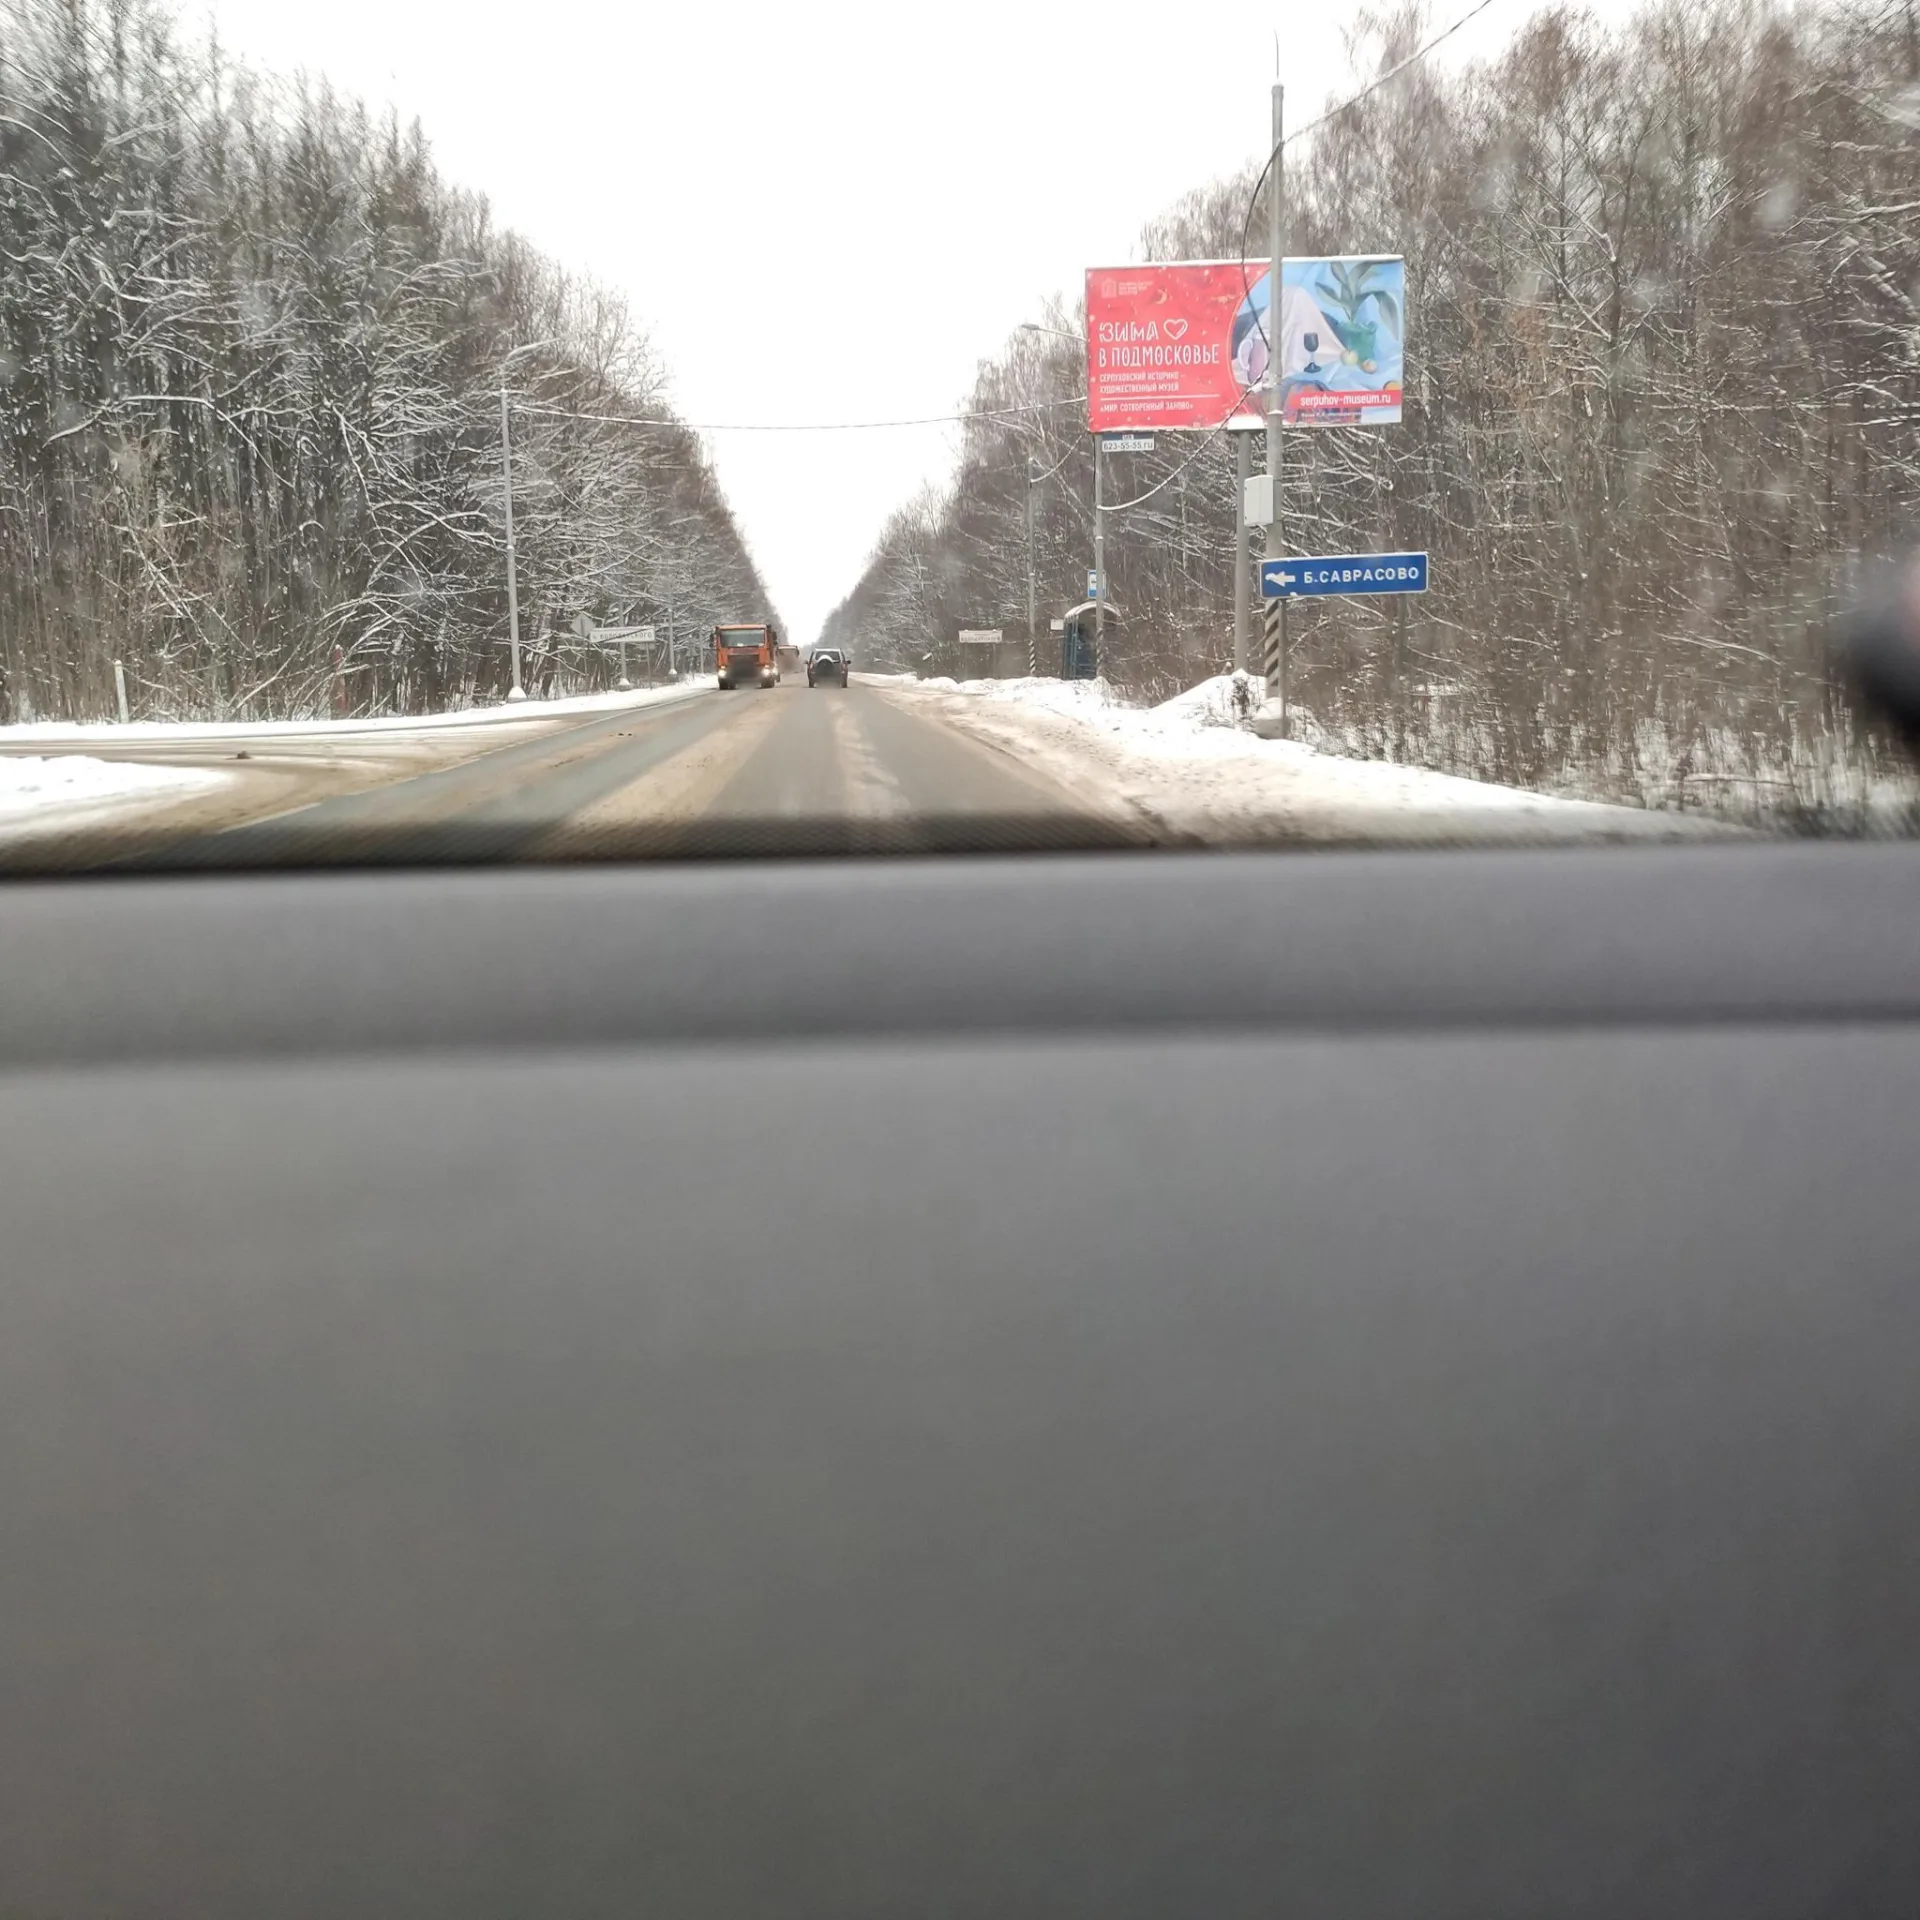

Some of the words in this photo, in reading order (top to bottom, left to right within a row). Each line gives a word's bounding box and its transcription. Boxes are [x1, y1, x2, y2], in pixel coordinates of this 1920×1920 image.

[1099, 321, 1159, 342] ЗИМА
[1099, 348, 1107, 367] В
[1111, 344, 1220, 367] ПОДМОСКОВЬЕ
[1100, 372, 1146, 382] СЕРПУХОВСКИЙ
[1100, 382, 1157, 394] ХУДОЖЕСТВЕННЫЙ
[1158, 381, 1179, 391] МУЗЕЙ
[1120, 401, 1164, 412] СОТВОРЕННЫЙ
[1300, 393, 1391, 408] serpuhov-museum.ru
[1303, 566, 1420, 585] Б.САВРАСОВО
